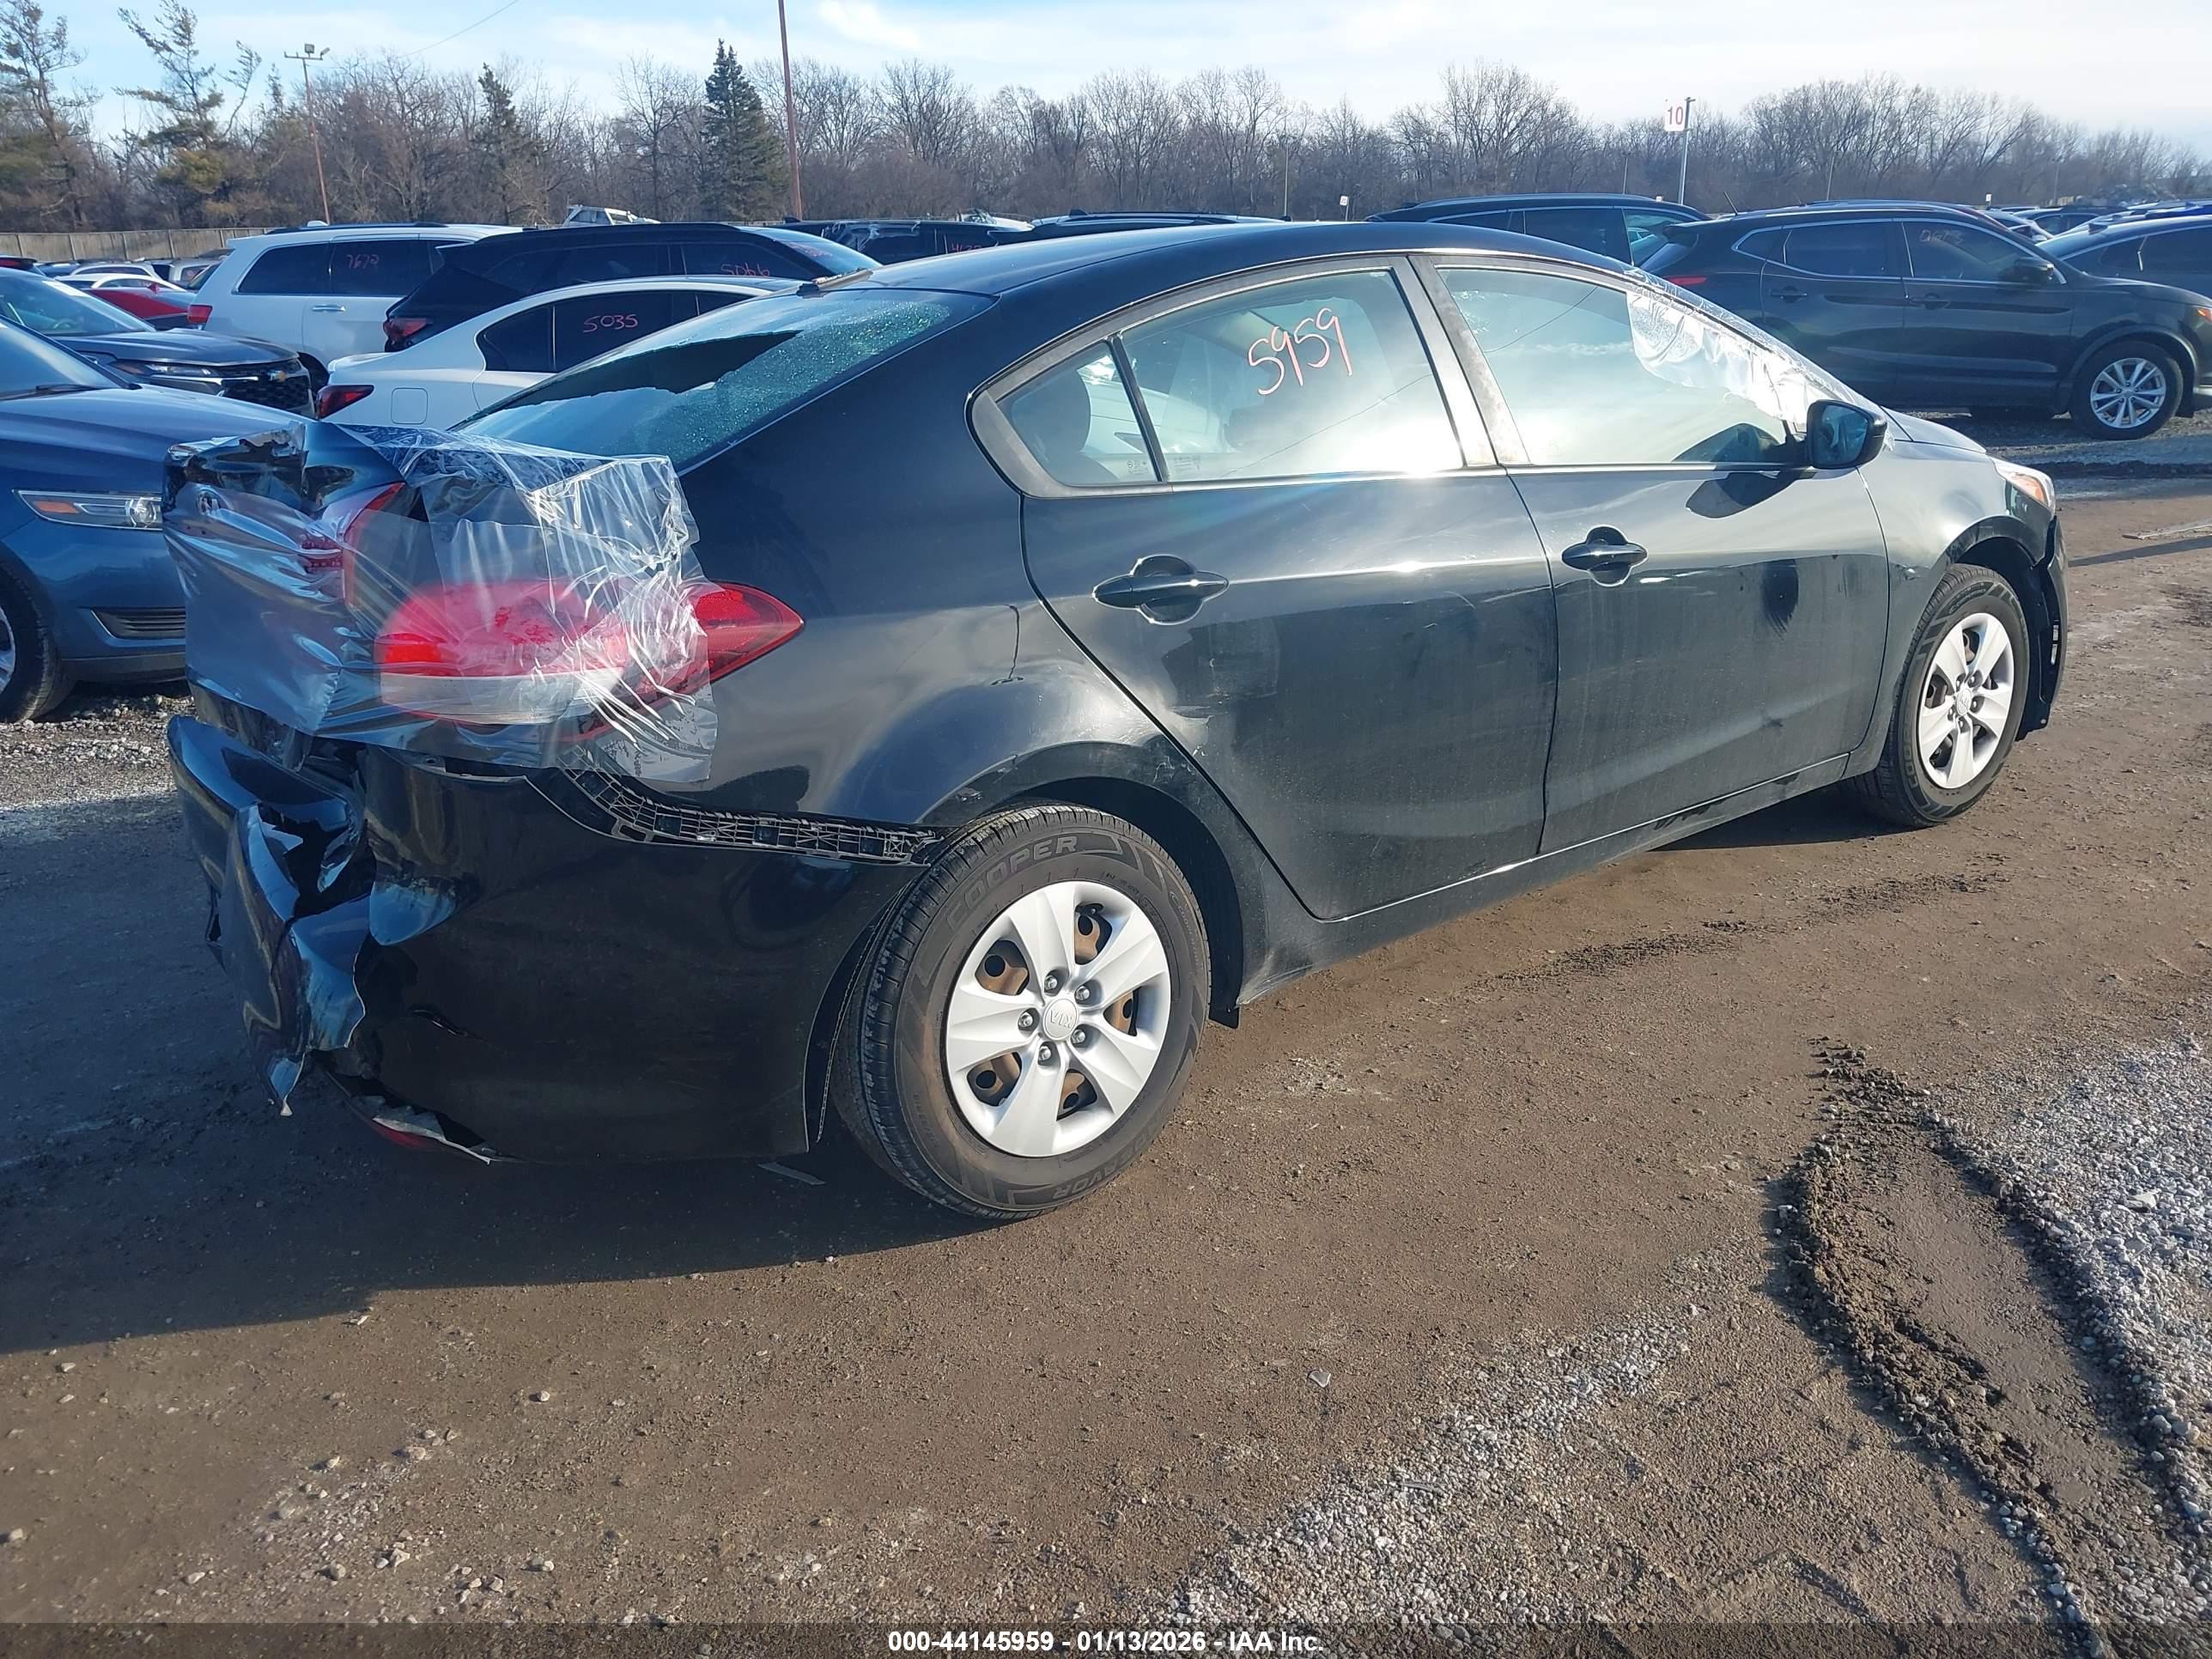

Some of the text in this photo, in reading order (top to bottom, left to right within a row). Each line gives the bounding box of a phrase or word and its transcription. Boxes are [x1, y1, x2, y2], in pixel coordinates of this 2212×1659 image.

[1667, 106, 1684, 125] 10
[583, 313, 639, 332] 5035
[1248, 307, 1353, 395] 5959
[947, 836, 1079, 931] COOPER
